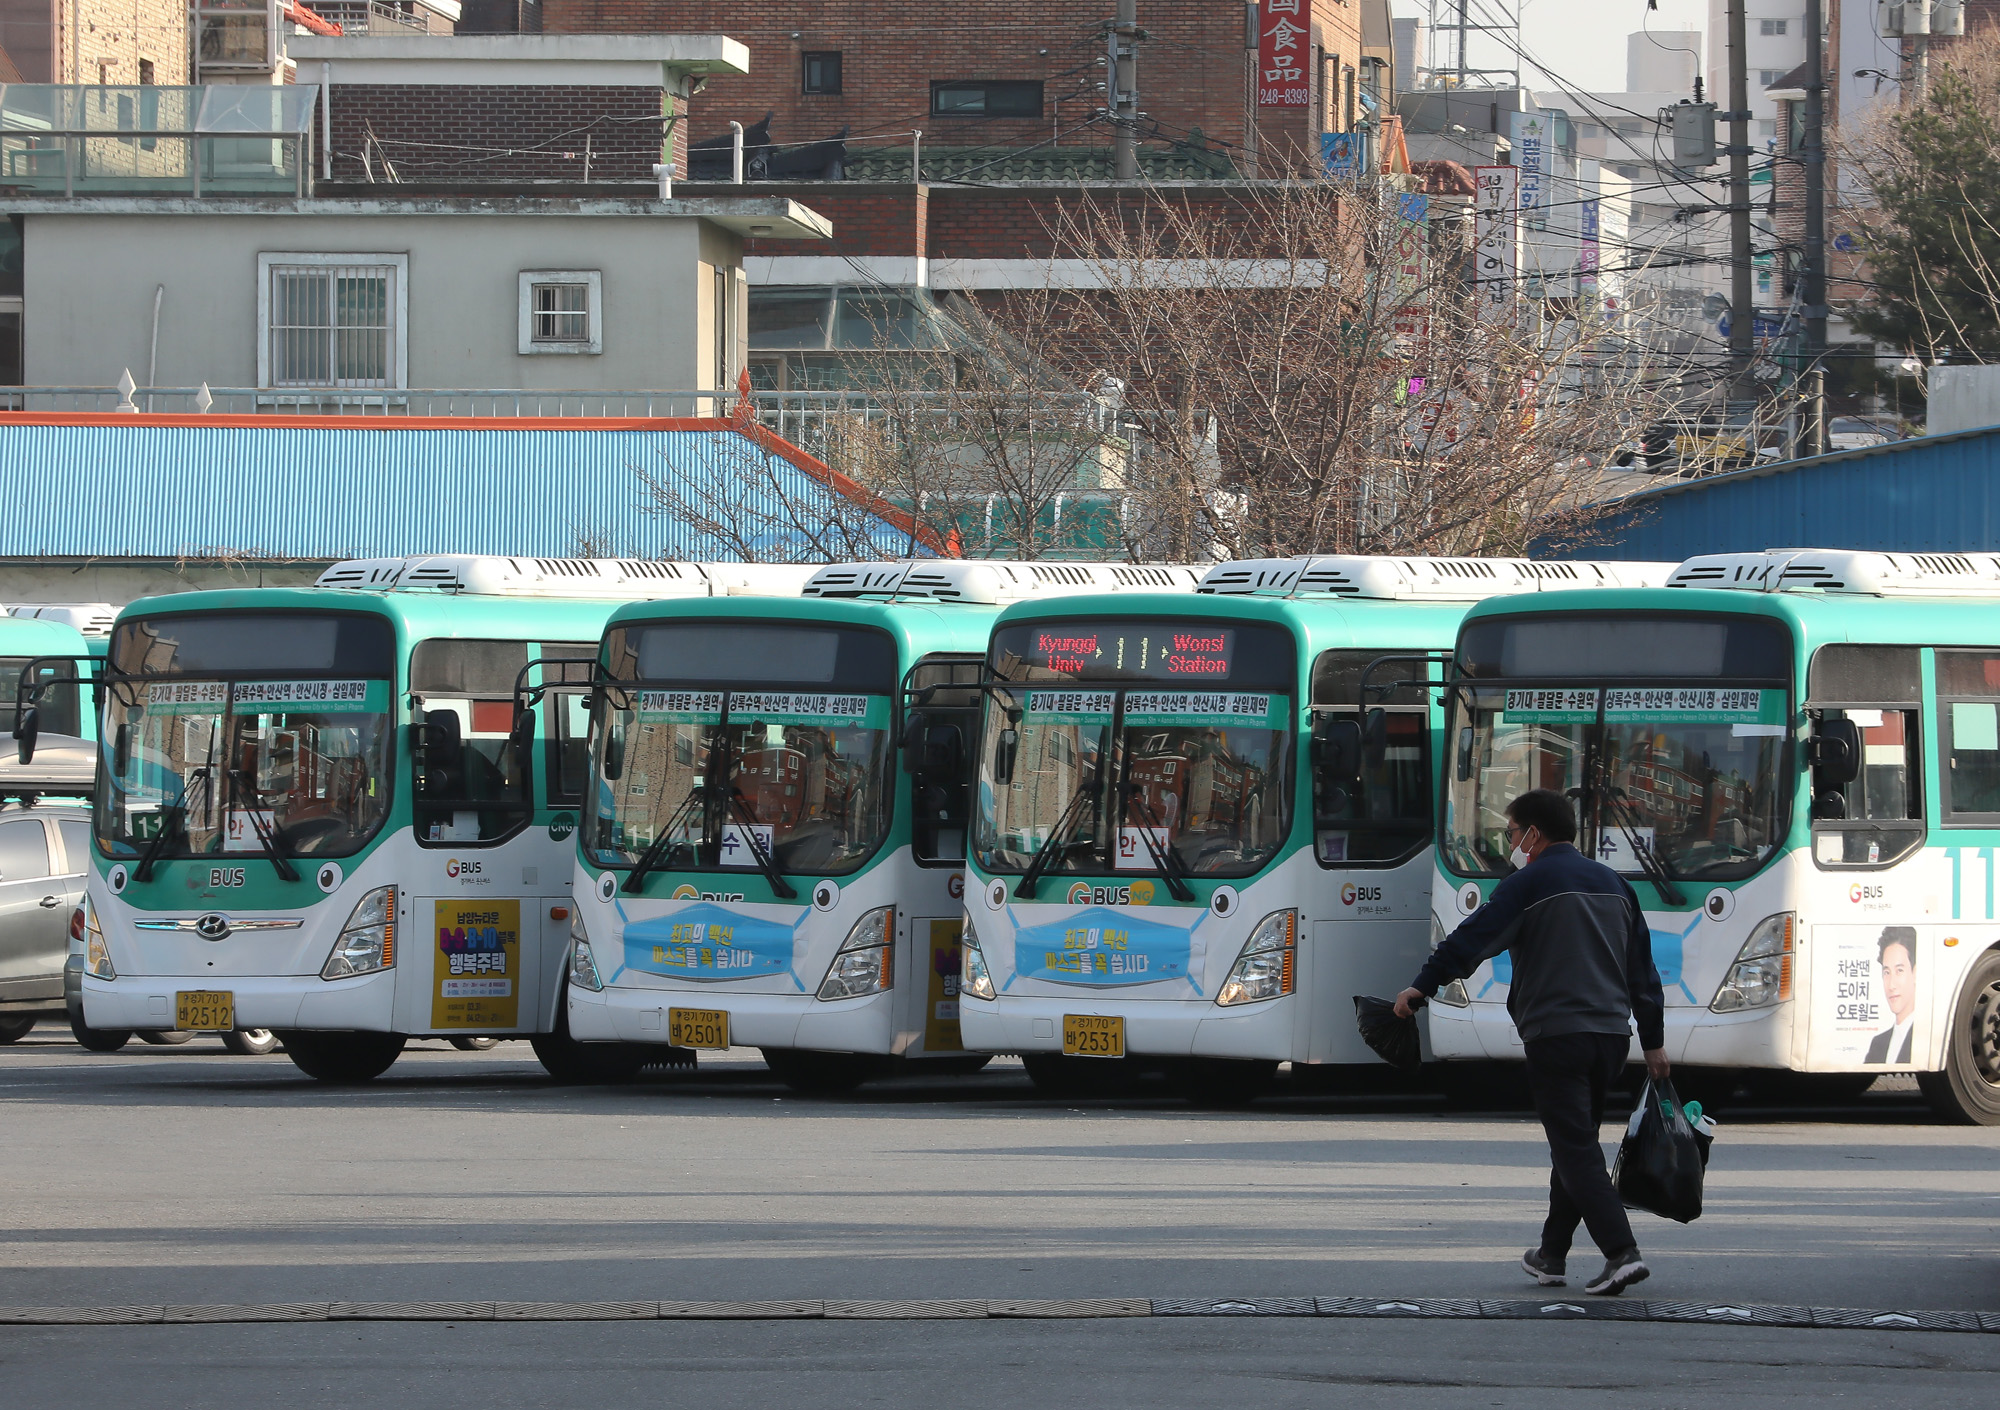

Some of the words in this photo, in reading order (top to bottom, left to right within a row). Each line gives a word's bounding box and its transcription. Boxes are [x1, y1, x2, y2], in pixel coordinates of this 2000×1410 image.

[1260, 88, 1308, 104] 248-8393
[1038, 634, 1097, 653] Kyunggi
[1173, 634, 1225, 652] Wonsi
[1048, 656, 1085, 672] Univ
[1168, 656, 1227, 673] Station
[150, 685, 172, 703] 경기대
[175, 684, 197, 702] 팔달문
[201, 683, 224, 701] 수원역
[233, 682, 264, 702] 상록수역
[267, 682, 291, 701] 안산역
[296, 682, 327, 700] 안산시청
[332, 682, 366, 699] 삼일제약
[1508, 691, 1534, 709] 경기대
[1537, 691, 1563, 709] 팔달문
[1567, 691, 1595, 710] 수원역
[1605, 691, 1641, 709] 상록수역
[1644, 691, 1674, 709] 안산역
[1679, 691, 1715, 709] 안산시청
[1721, 691, 1759, 709] 삼일제약
[642, 693, 665, 711] 경기대
[667, 693, 691, 711] 팔달문
[695, 694, 719, 711] 수원역
[729, 694, 761, 711] 상록수역
[764, 695, 789, 713] 안산역
[794, 696, 827, 714] 안산시청
[832, 697, 866, 715] 삼일제약
[1031, 693, 1054, 711] 경기대
[1057, 694, 1082, 711] 팔달문
[1086, 694, 1111, 712] 수원역
[1125, 695, 1158, 713] 상록수역
[1161, 695, 1188, 712] 안산역
[1192, 695, 1227, 713] 안산시청
[1232, 695, 1267, 714] 삼일제약
[551, 821, 573, 832] CNG
[209, 868, 245, 887] BUS
[1943, 847, 1994, 919] 11
[457, 911, 499, 924] 남양뉴타운
[498, 931, 516, 944] 블록
[670, 923, 706, 944] 최고의
[708, 924, 734, 946] 백신
[1064, 928, 1100, 949] 최고의
[1102, 928, 1129, 950] 백신
[449, 952, 506, 975] 행복주택
[652, 945, 699, 969] 마스크를
[700, 948, 713, 969] 꼭
[716, 948, 754, 969] 씁시다
[1045, 952, 1092, 974] 마스크를
[1094, 953, 1108, 974] 꼭
[1110, 953, 1149, 974] 씁시다
[1837, 959, 1870, 977] 차살땐
[206, 994, 219, 1004] 70
[1837, 981, 1870, 1000] 도이치
[700, 1012, 713, 1022] 70
[1836, 1003, 1879, 1021] 오토월드
[1095, 1018, 1109, 1029] 70
